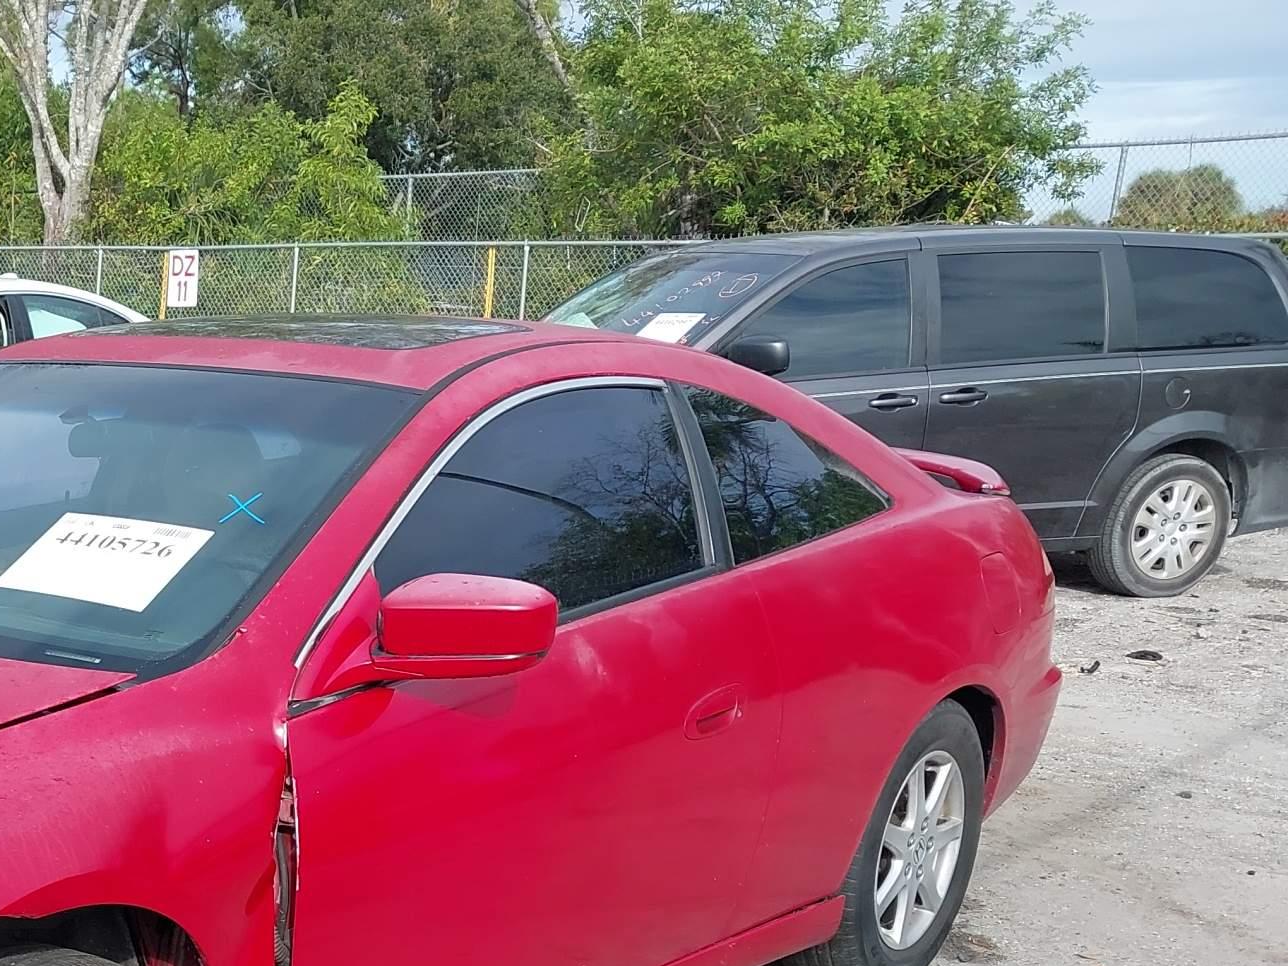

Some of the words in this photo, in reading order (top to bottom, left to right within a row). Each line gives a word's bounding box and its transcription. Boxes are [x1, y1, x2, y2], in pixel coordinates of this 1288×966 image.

[172, 255, 195, 277] DZ
[177, 280, 187, 302] 11
[56, 530, 175, 558] 44105726
